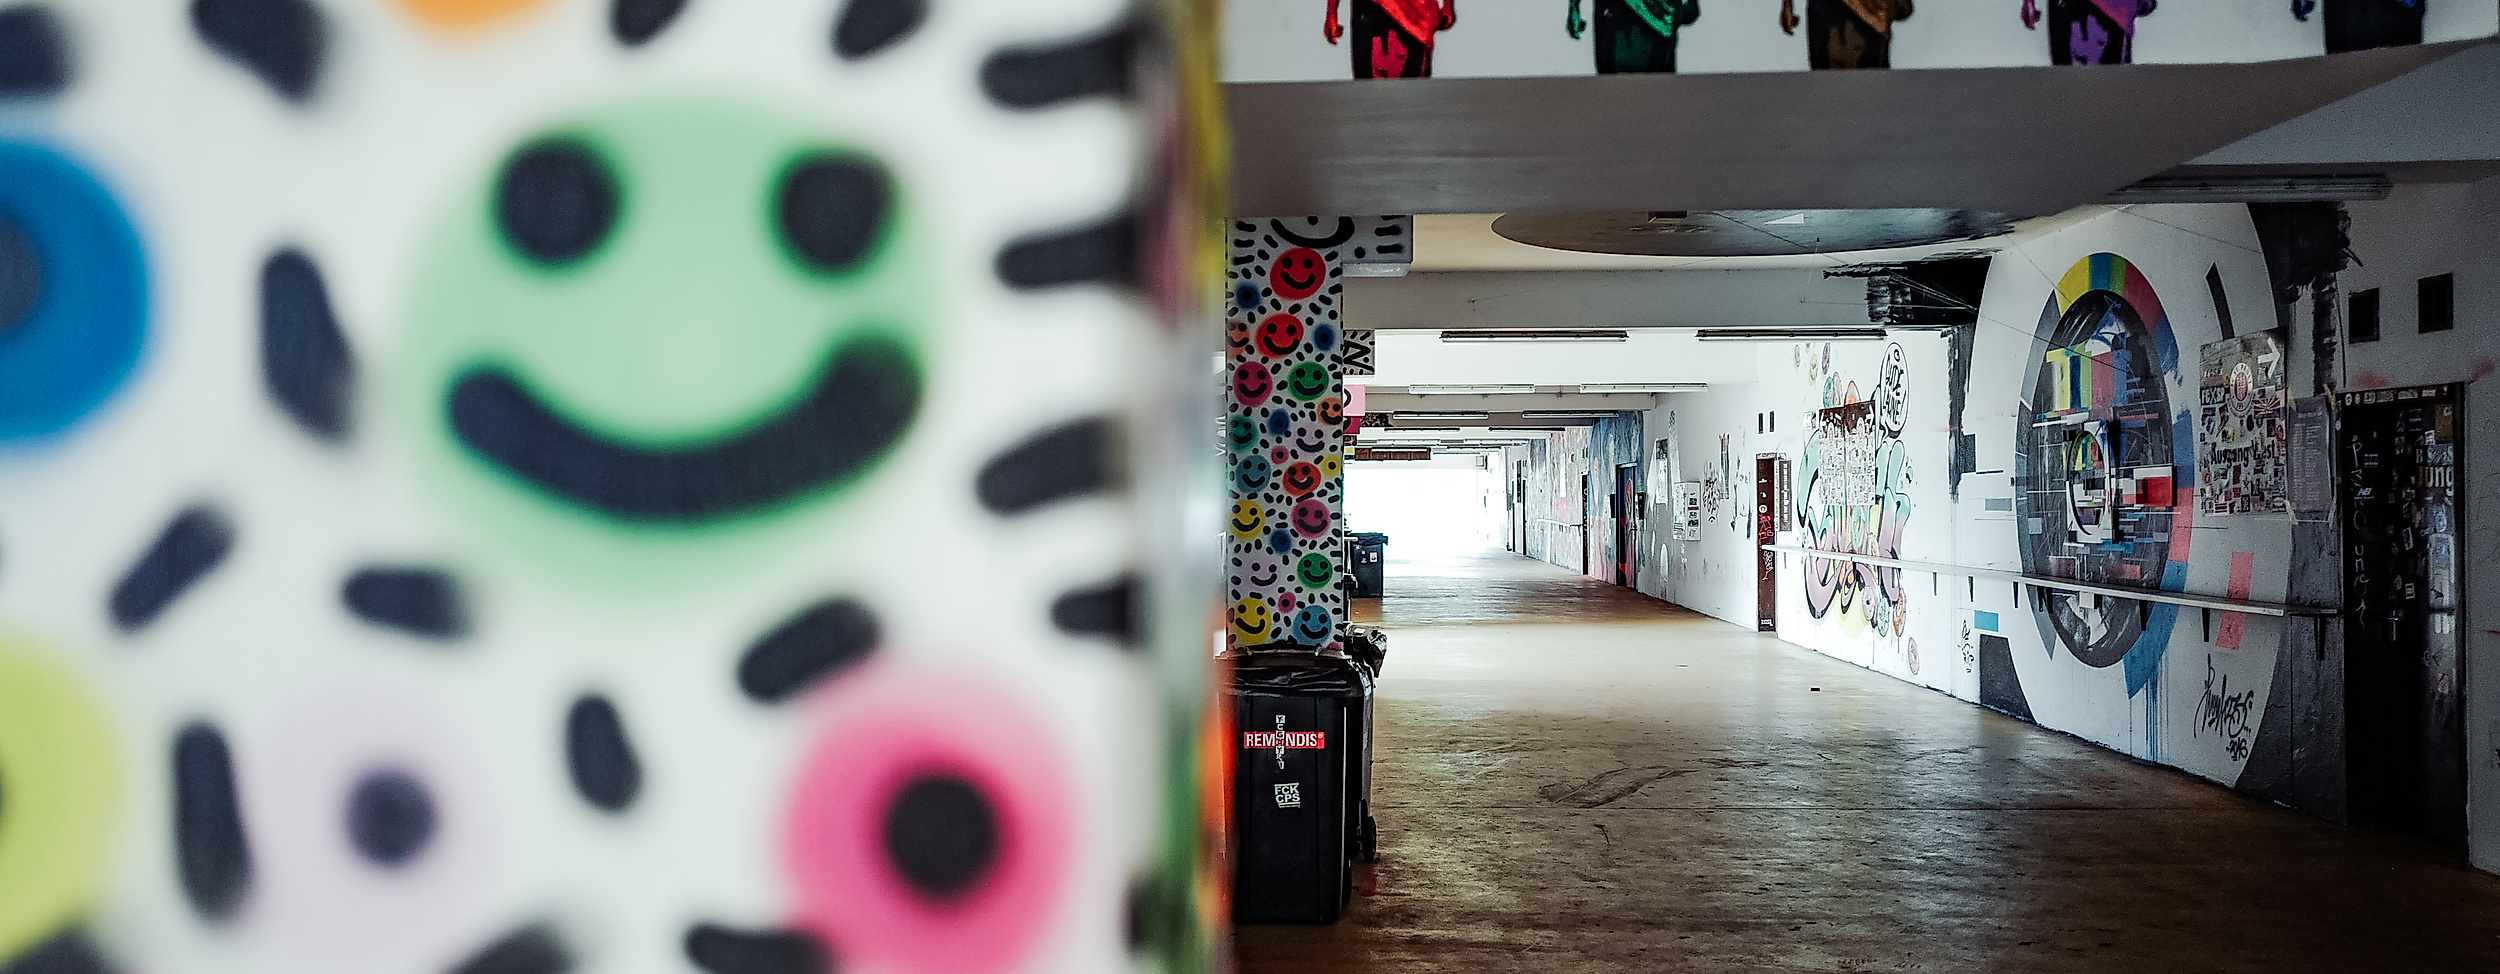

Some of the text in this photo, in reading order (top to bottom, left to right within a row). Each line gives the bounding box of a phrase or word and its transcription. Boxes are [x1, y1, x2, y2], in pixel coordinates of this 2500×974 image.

[2211, 442, 2250, 469] Ausgang
[1245, 733, 1318, 747] REMNDIS
[1275, 785, 1299, 795] FCK
[1275, 793, 1301, 803] CPS
